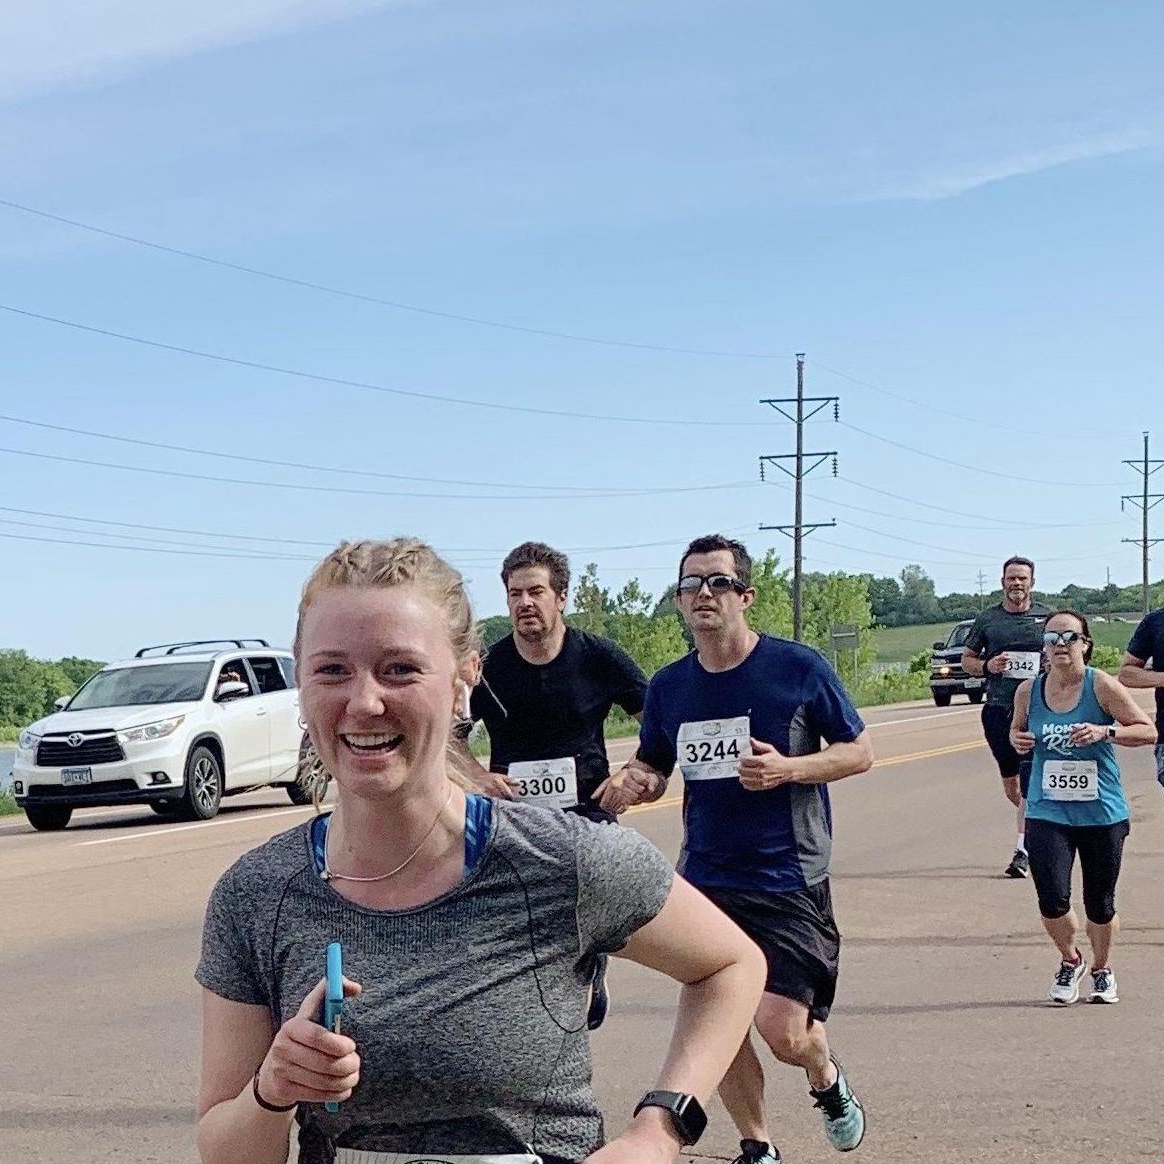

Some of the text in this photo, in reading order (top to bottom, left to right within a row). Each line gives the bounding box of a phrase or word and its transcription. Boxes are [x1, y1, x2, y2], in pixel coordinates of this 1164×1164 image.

[1008, 661, 1034, 671] 3342
[685, 738, 741, 763] 3244
[518, 777, 566, 797] 3300
[1048, 774, 1089, 789] 3559
